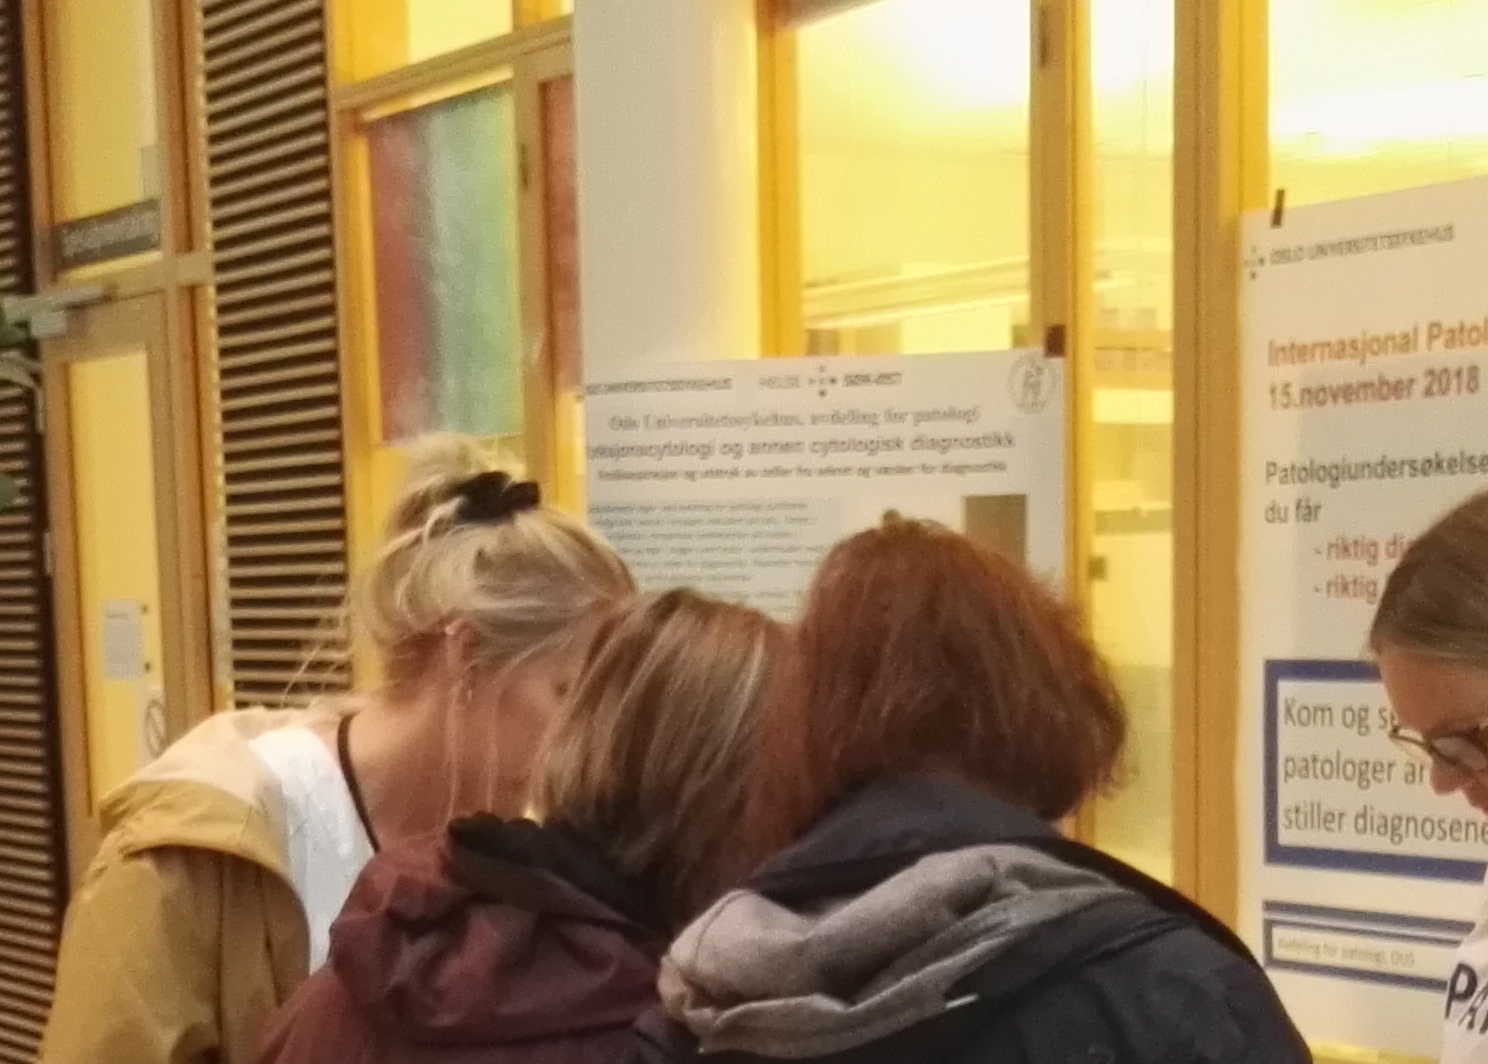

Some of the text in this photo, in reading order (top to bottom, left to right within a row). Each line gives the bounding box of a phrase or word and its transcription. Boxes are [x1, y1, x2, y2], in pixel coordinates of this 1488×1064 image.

[1270, 246, 1304, 266] OSLO
[1267, 322, 1420, 366] Internasjonal
[1422, 363, 1481, 399] 2018
[720, 441, 743, 461] og
[750, 439, 804, 455] annen
[810, 435, 903, 458] cytologisk
[910, 430, 1016, 455] diagnostikk
[1264, 497, 1322, 524] du får
[1326, 530, 1379, 567] riktig
[1326, 574, 1378, 605] riktig
[1283, 697, 1334, 728] Kom
[1340, 704, 1370, 737] og
[1283, 749, 1397, 790] patologer
[1283, 797, 1347, 833] stiller
